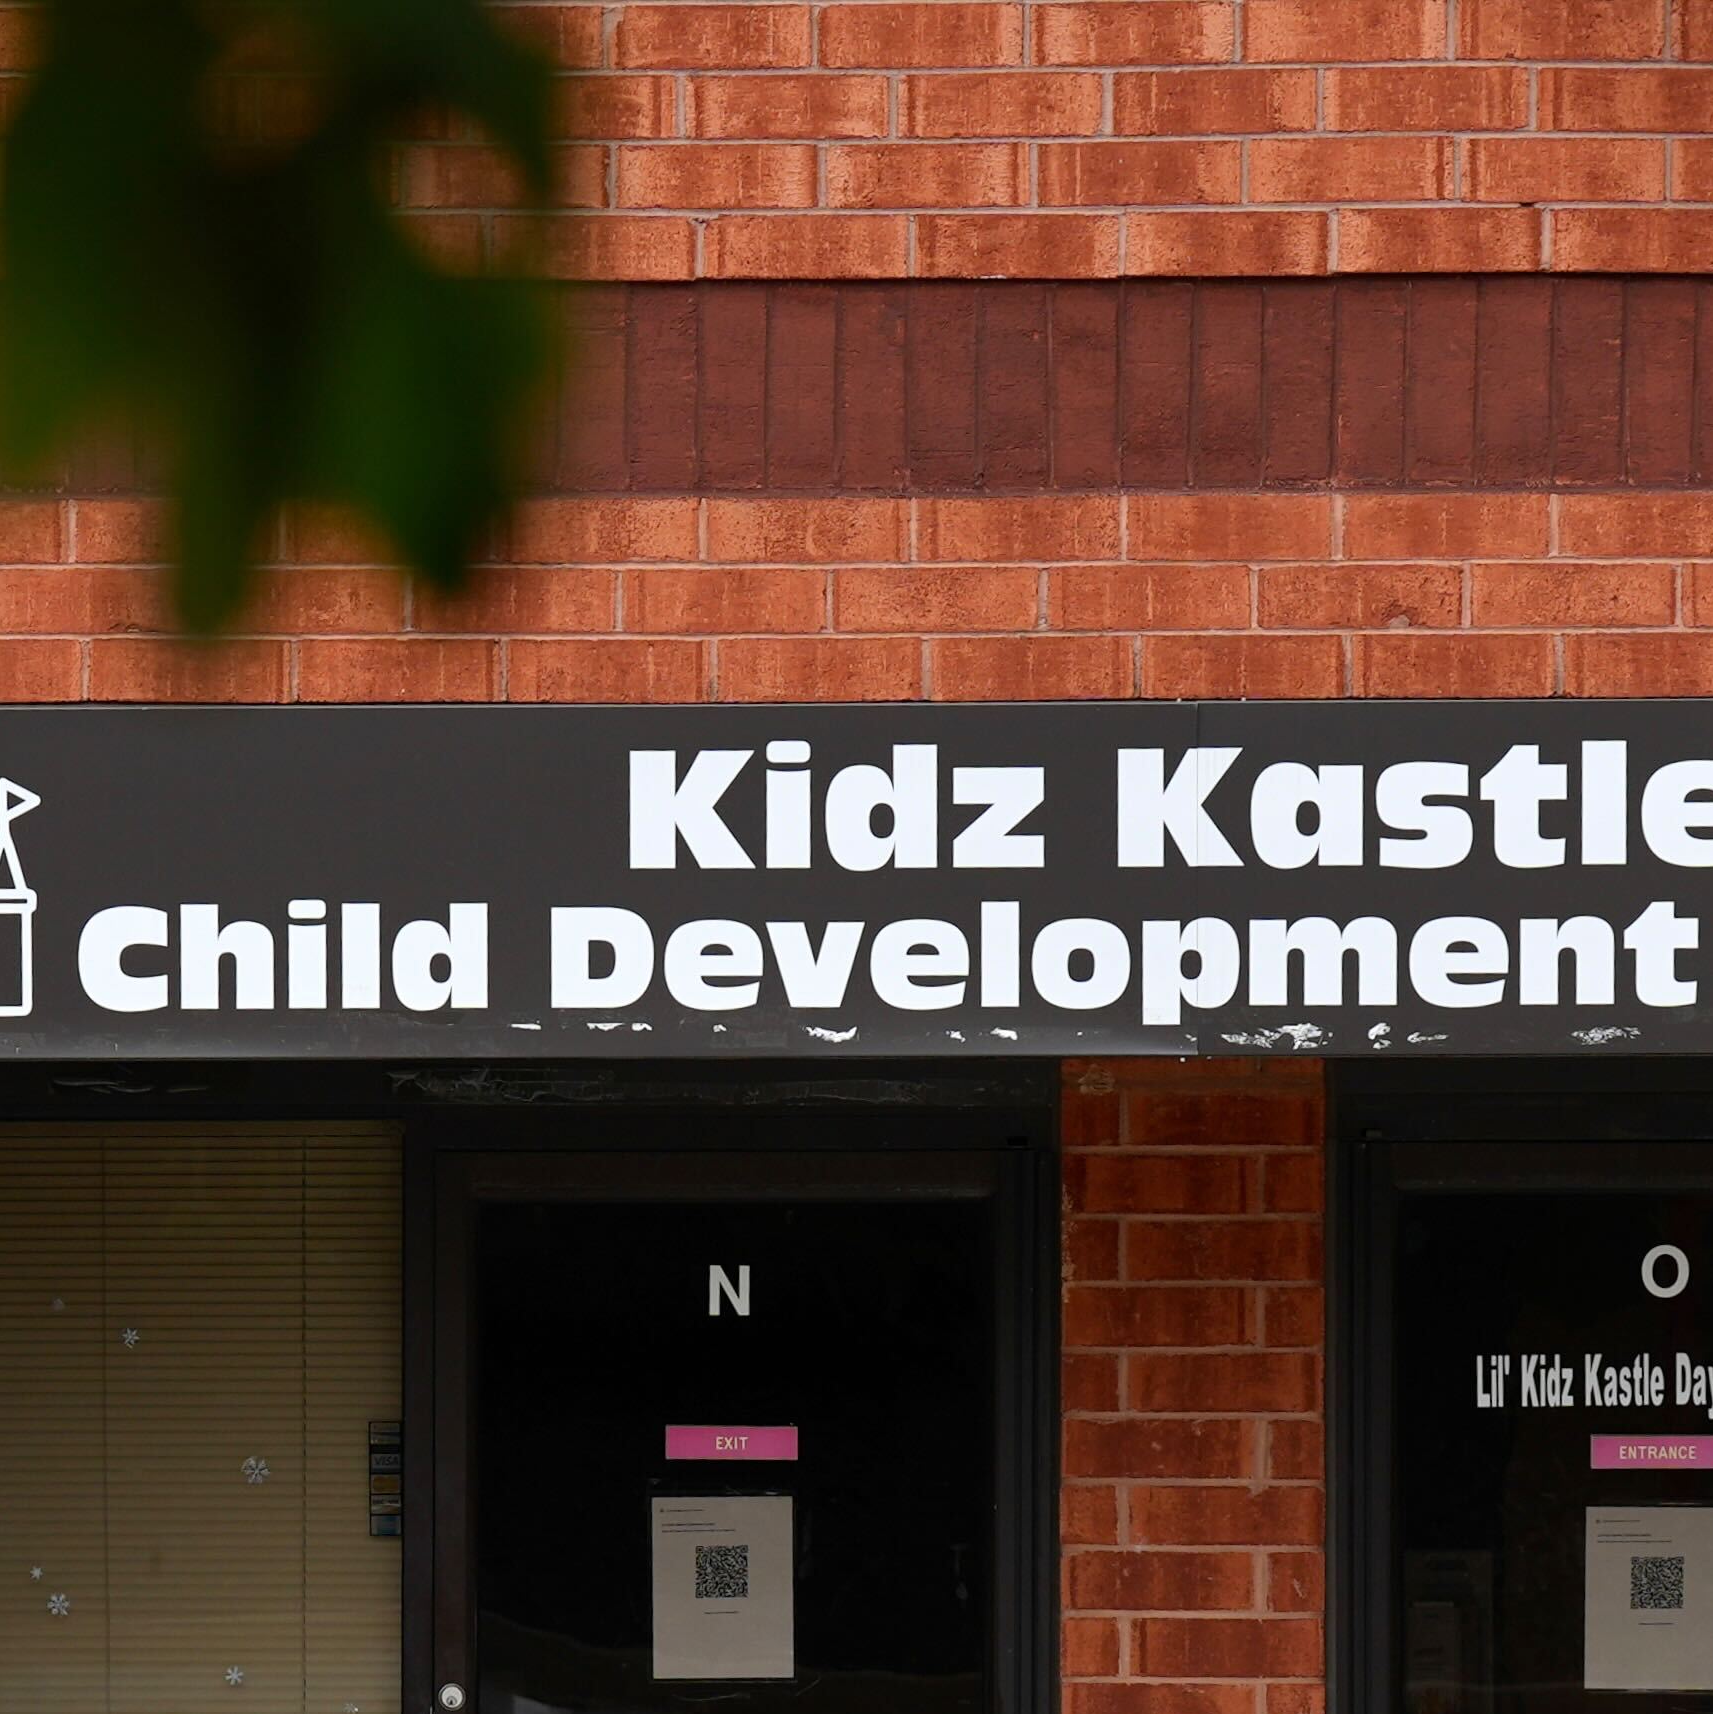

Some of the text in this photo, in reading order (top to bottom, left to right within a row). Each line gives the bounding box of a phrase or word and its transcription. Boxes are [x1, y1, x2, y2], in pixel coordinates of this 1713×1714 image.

[630, 741, 1044, 871] Kidz
[78, 898, 488, 1013] Child
[551, 899, 1698, 1027] Development
[709, 1265, 750, 1315] N
[1642, 1245, 1689, 1298] O
[1477, 1355, 1509, 1407] Lil'
[1522, 1354, 1573, 1407] Kidz
[1585, 1354, 1664, 1406] Kastle
[374, 1455, 399, 1466] VISA
[715, 1436, 749, 1450] EXIT
[1619, 1445, 1697, 1460] ENTRANCE
